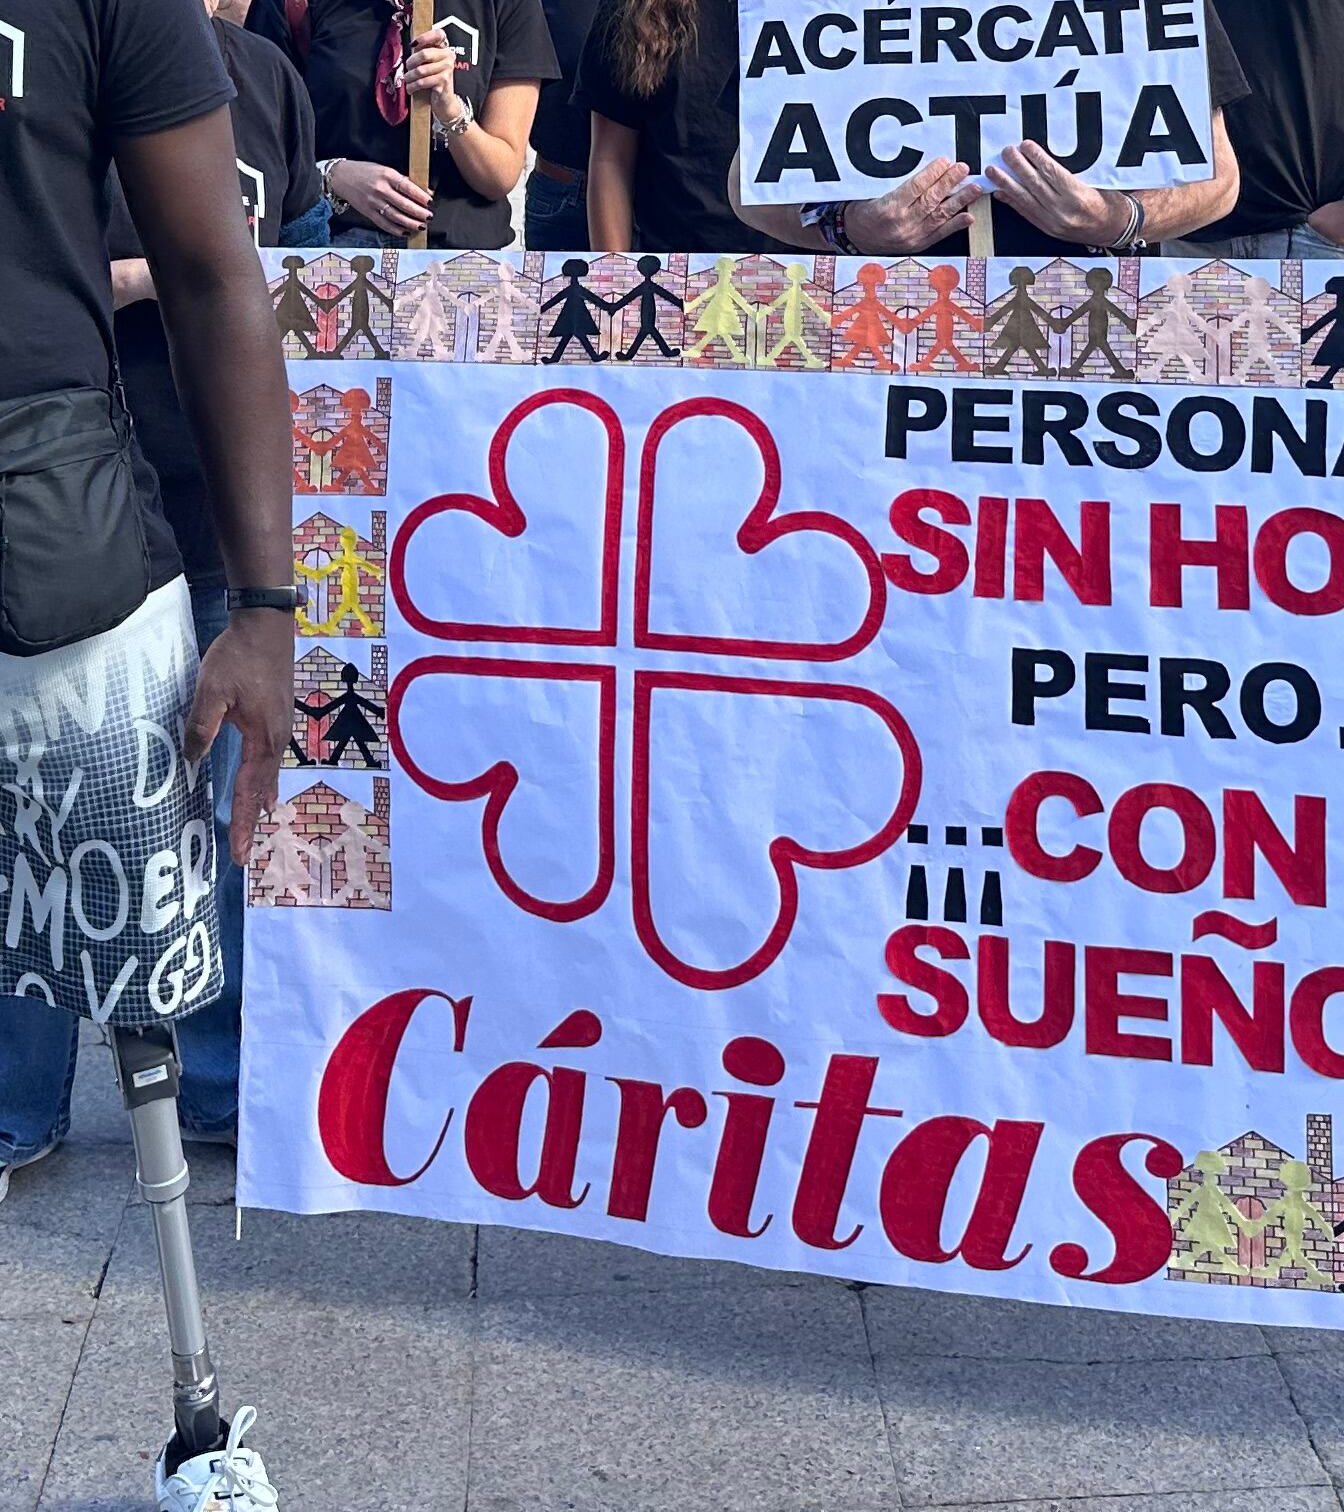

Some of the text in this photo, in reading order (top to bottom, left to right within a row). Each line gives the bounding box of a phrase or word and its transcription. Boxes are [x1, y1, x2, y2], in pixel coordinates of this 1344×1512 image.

[754, 69, 1208, 184] ACTÚA
[880, 488, 1112, 606] SIN
[318, 988, 1184, 1285] Cáritas
